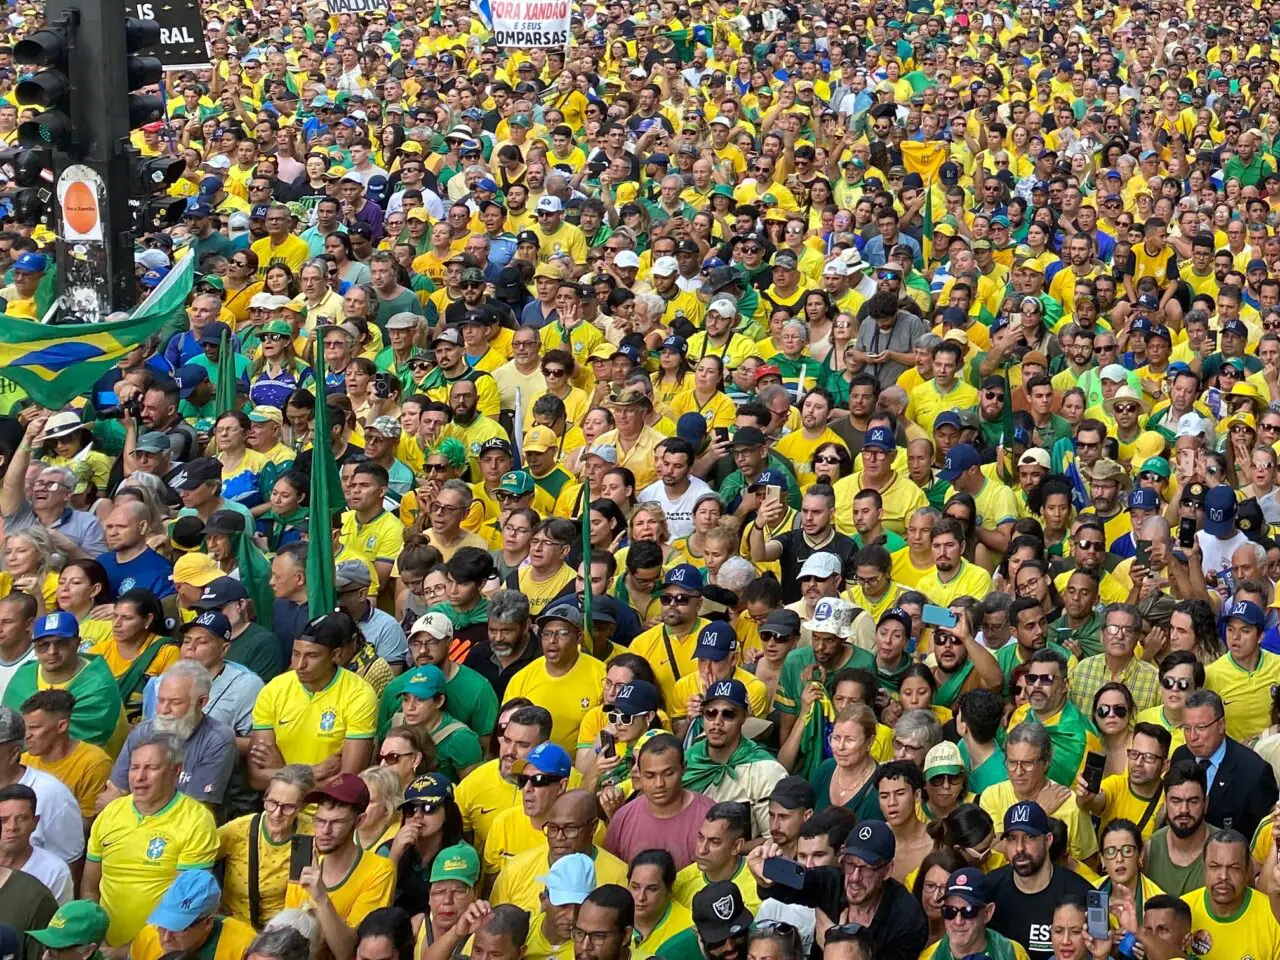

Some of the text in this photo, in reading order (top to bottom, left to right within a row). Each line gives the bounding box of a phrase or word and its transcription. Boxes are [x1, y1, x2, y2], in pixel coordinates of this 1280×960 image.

[136, 4, 155, 20] IS
[491, 0, 520, 20] FORA
[514, 21, 542, 30] E SEUS
[160, 26, 194, 44] RAL
[496, 30, 567, 45] OMPARSAS
[486, 438, 503, 448] UFC
[1210, 508, 1223, 521] M
[671, 569, 685, 581] M
[197, 612, 215, 625] M
[703, 632, 717, 646] M
[619, 686, 634, 698] M
[715, 682, 732, 696] M
[1011, 805, 1030, 823] M
[1030, 924, 1052, 941] ES
